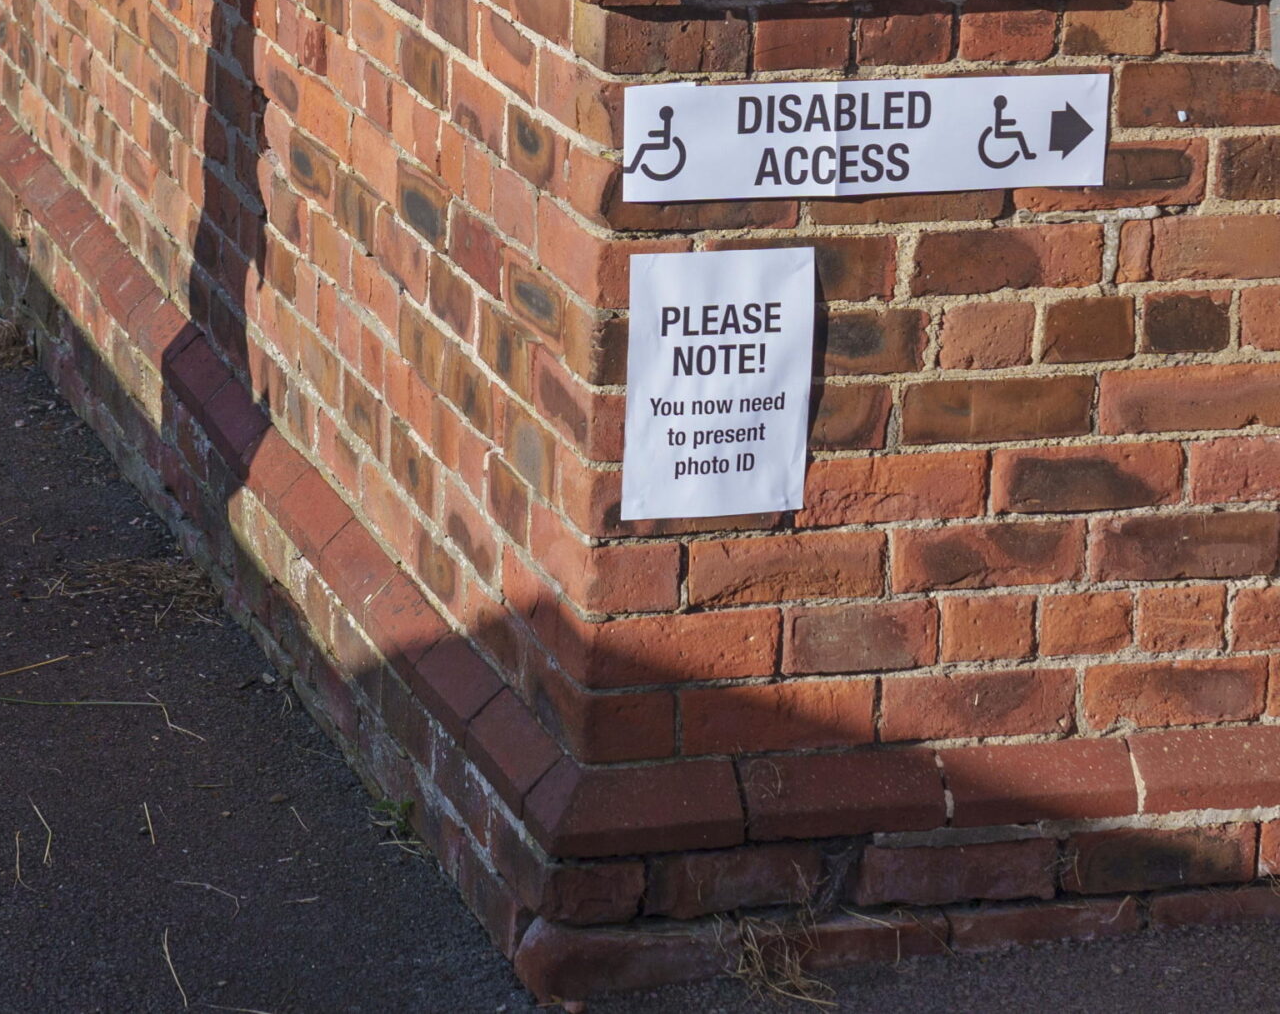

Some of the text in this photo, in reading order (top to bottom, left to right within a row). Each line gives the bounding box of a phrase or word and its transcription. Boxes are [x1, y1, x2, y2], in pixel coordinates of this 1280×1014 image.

[737, 90, 932, 135] DISABLED
[754, 142, 910, 186] ACCESS
[661, 302, 782, 337] PLEASE
[672, 343, 766, 377] NOTE!
[650, 392, 786, 417] You now need
[667, 423, 766, 450] to present
[674, 452, 756, 480] photo ID
